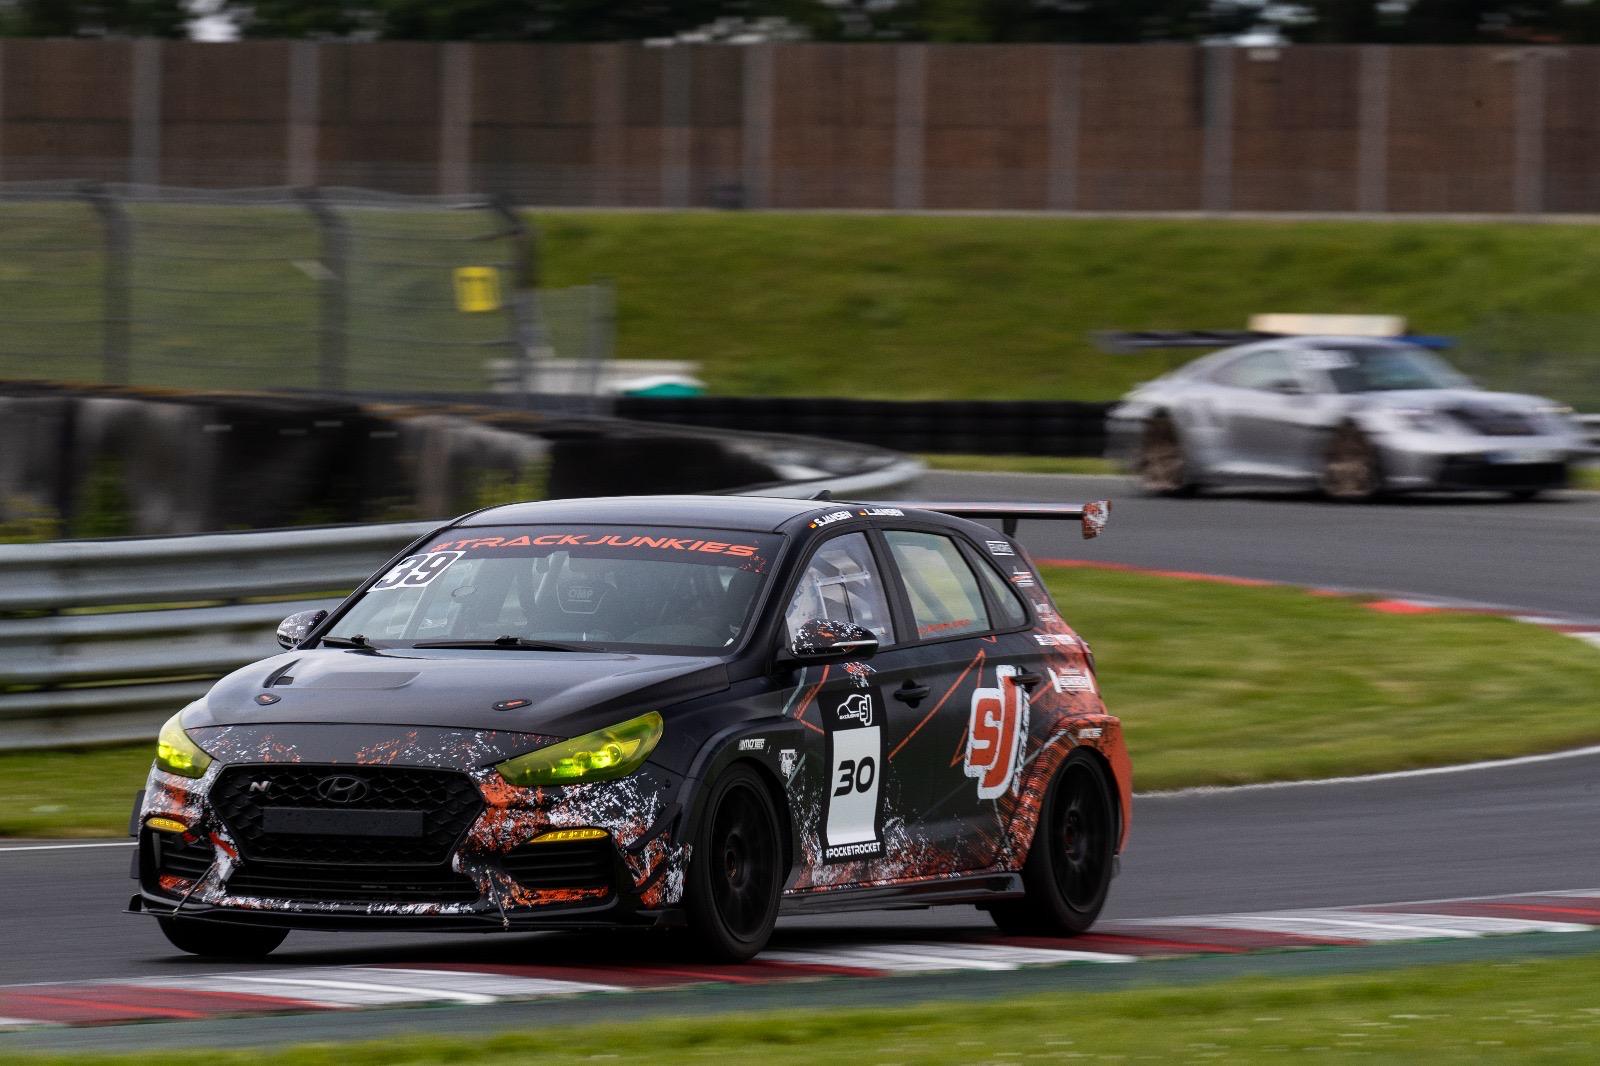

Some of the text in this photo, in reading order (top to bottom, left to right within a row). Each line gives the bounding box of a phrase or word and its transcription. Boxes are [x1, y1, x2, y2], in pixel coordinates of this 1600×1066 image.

[431, 534, 760, 557] #TRACKJUNKIES
[374, 552, 459, 589] 39
[833, 756, 875, 798] 30
[826, 842, 881, 859] #POCKETROCKET
